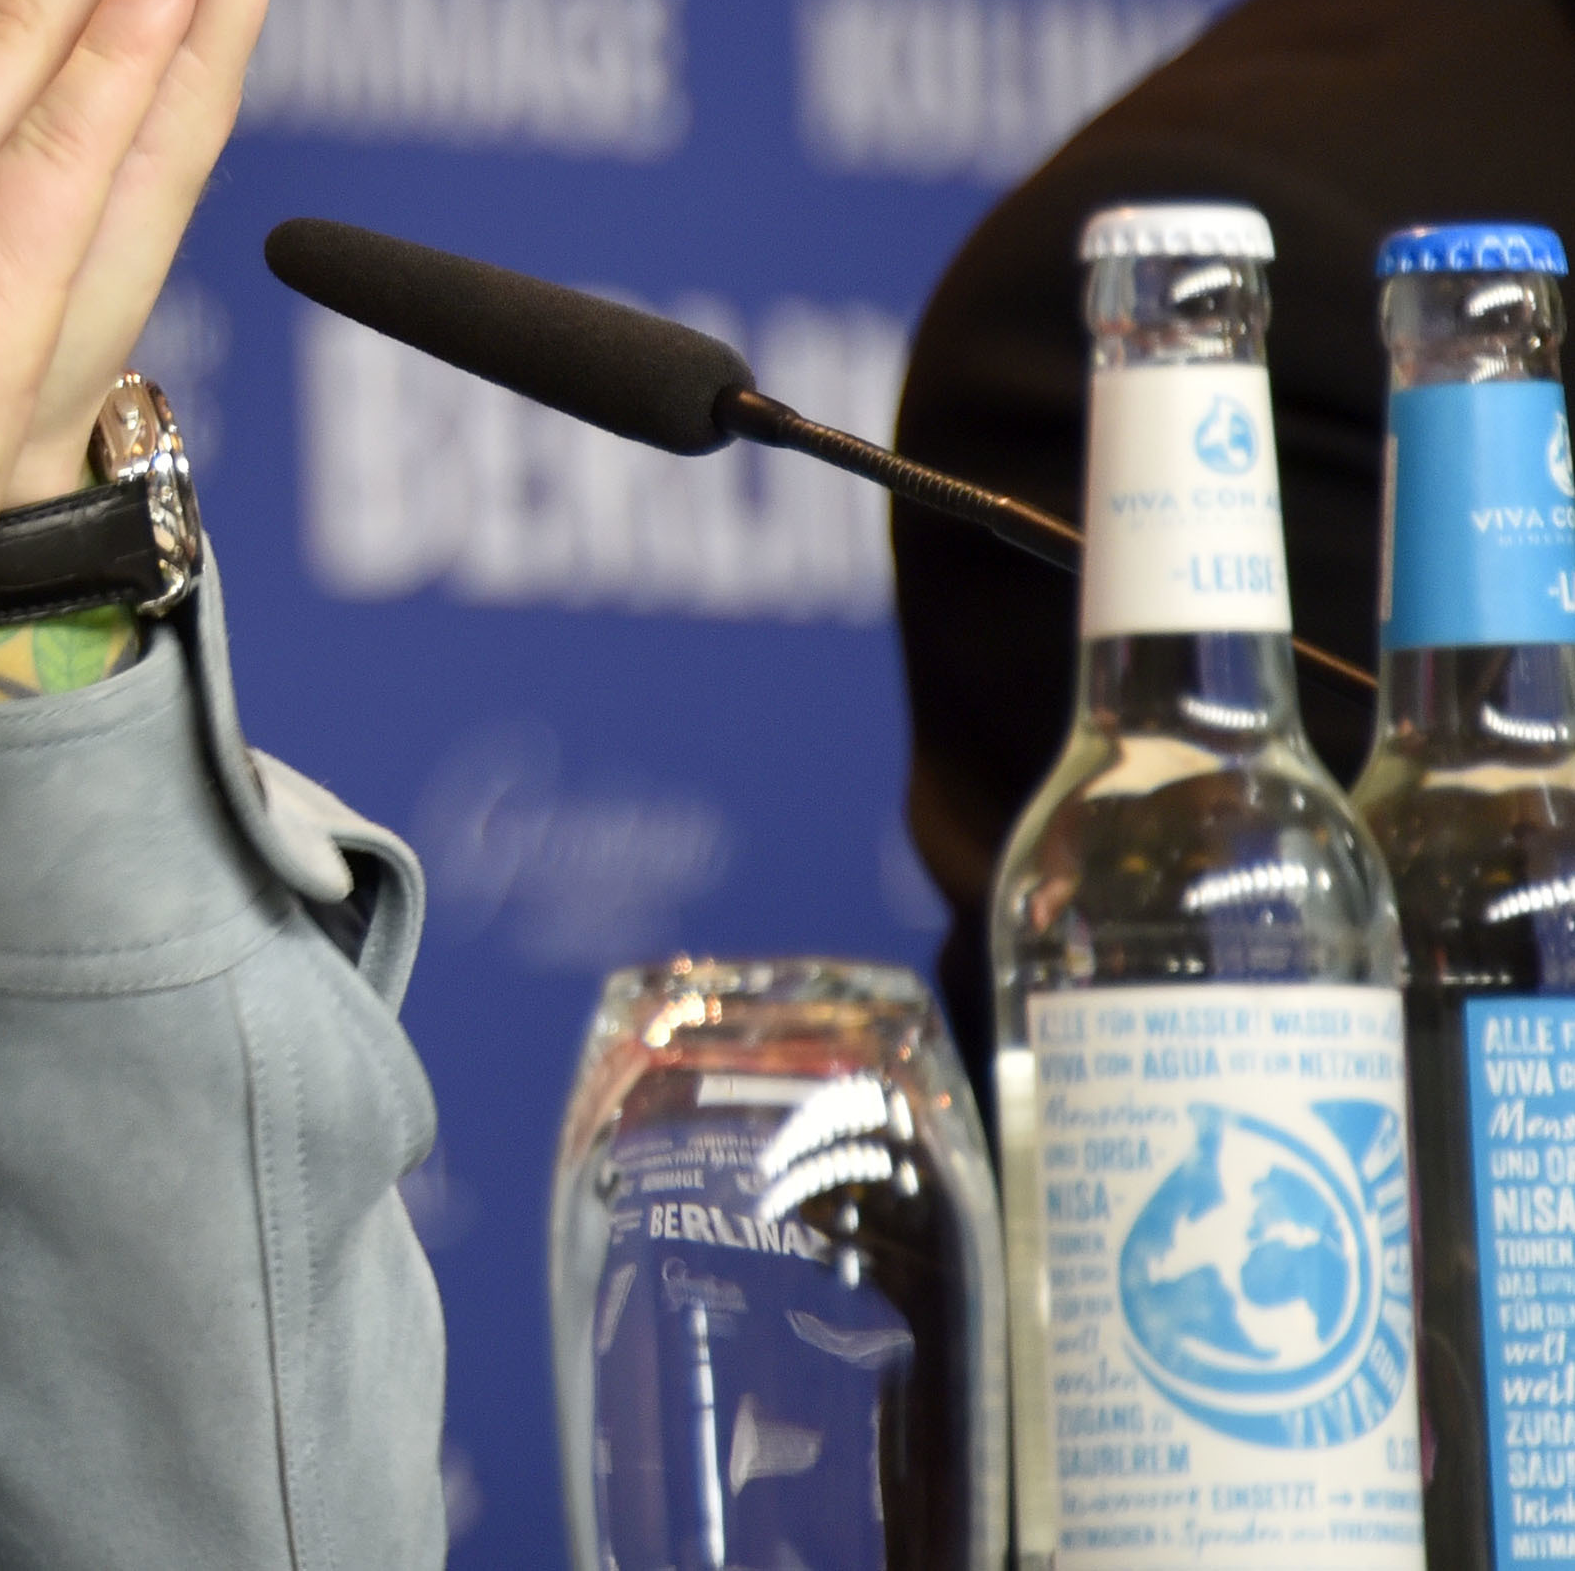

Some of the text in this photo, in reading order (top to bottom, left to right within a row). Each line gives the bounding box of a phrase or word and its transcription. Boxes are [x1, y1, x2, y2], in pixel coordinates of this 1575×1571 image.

[1109, 490, 1179, 516] VIVA
[1192, 486, 1256, 511] CON
[1471, 507, 1545, 533] VIVA
[1485, 1016, 1555, 1056] ALLE
[1143, 1047, 1222, 1080] AGUA
[1485, 1059, 1554, 1096] VIVA
[1492, 1148, 1540, 1179] UND
[1499, 1297, 1543, 1332] FÜR
